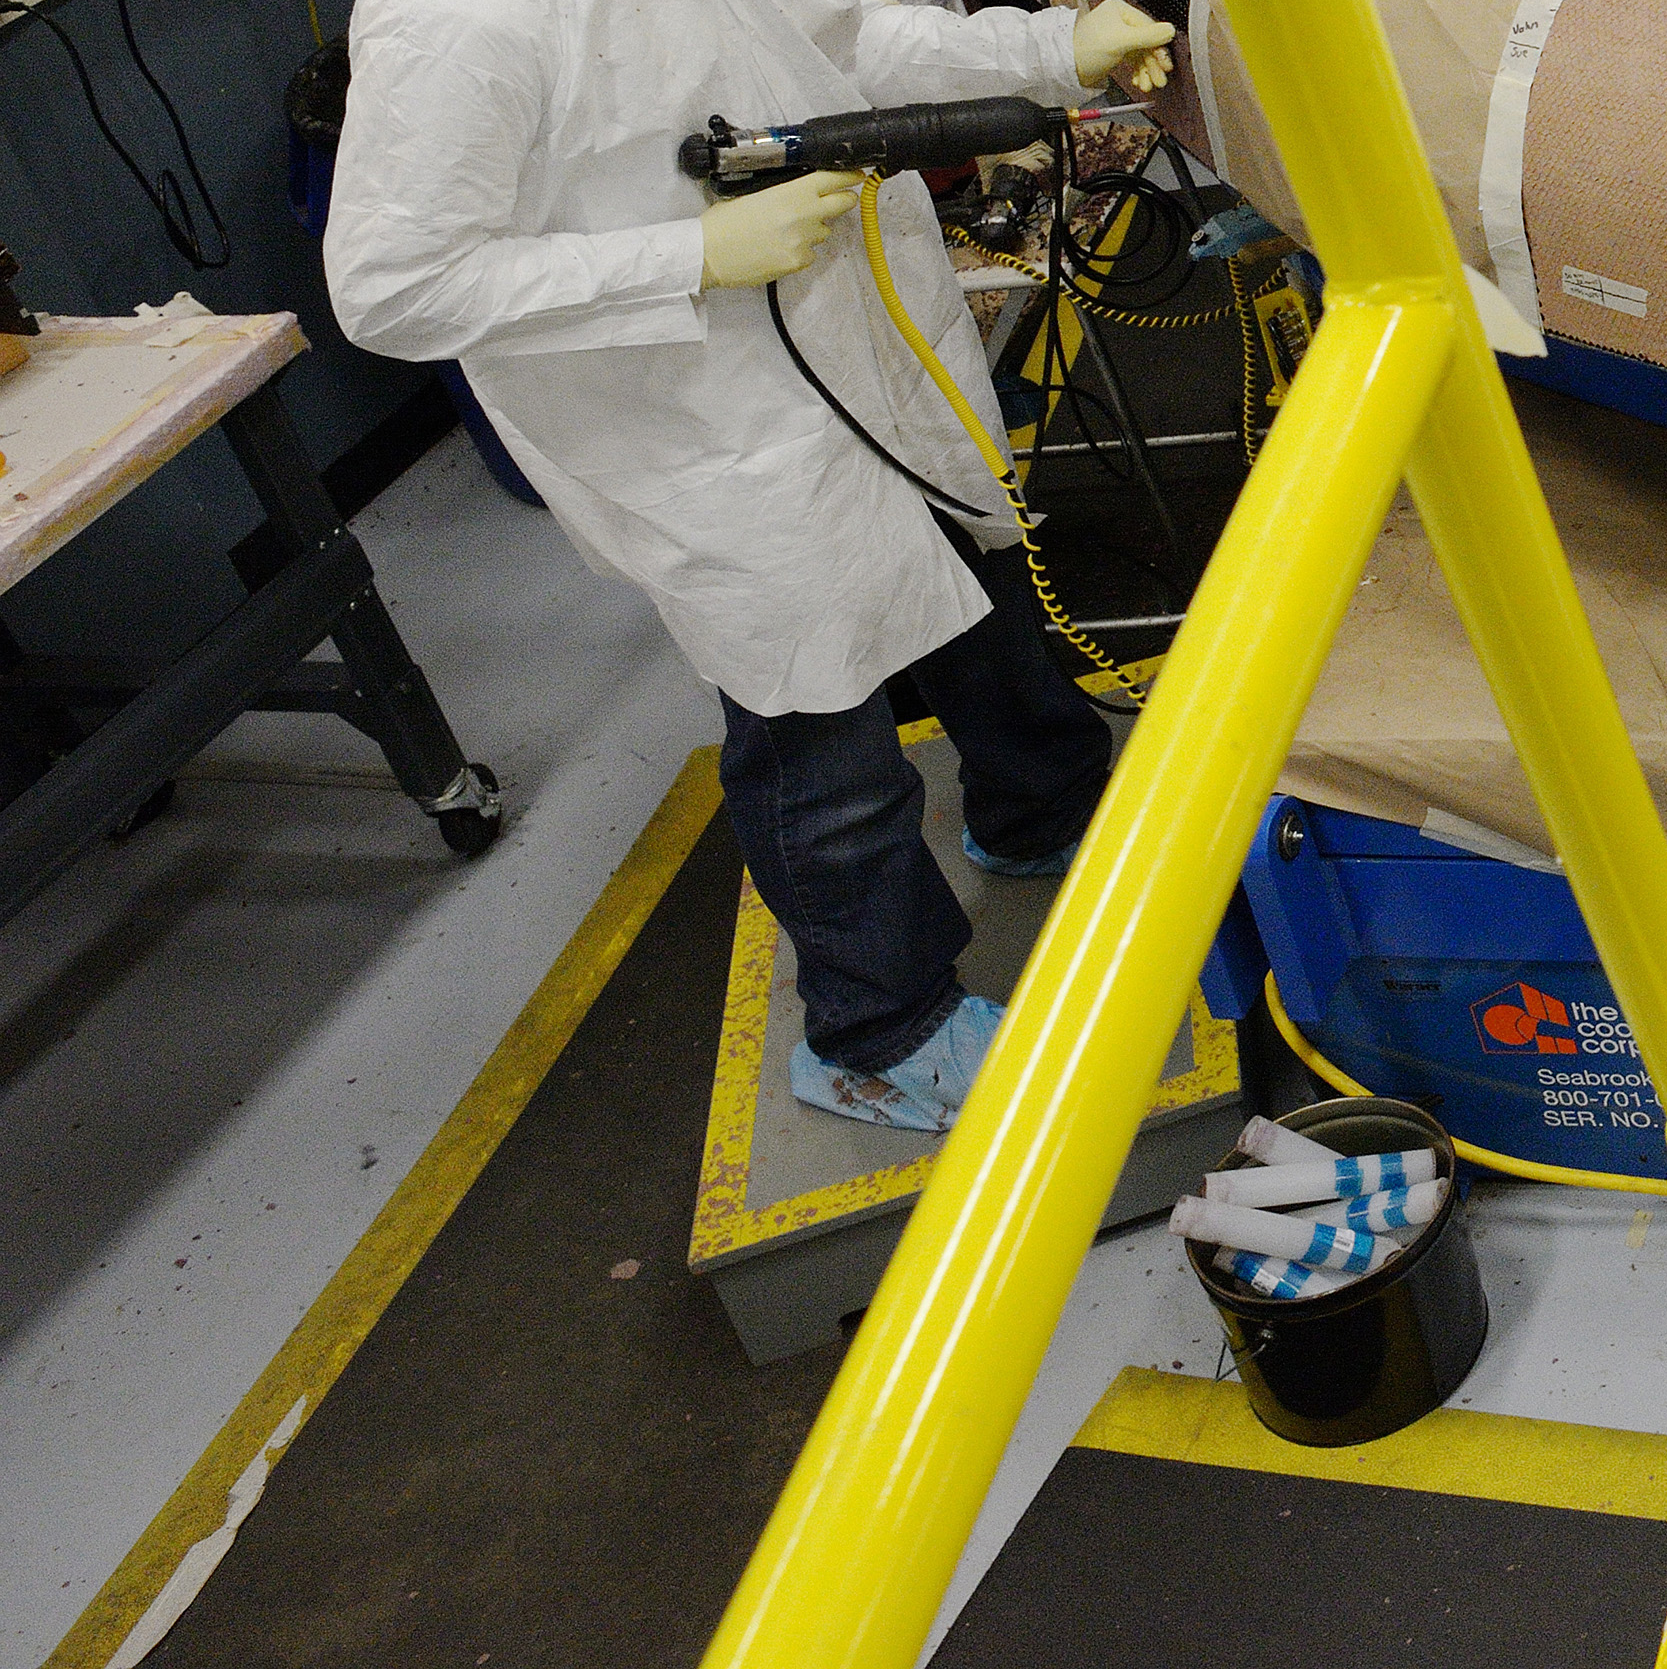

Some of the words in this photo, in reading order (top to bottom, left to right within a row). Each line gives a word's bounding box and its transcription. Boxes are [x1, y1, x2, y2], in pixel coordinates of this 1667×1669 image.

[1571, 1001, 1618, 1022] the
[1576, 1021, 1633, 1039] coo
[1582, 1037, 1641, 1058] corp
[1537, 1067, 1652, 1087] Seabrook
[1542, 1089, 1663, 1108] 800-701-
[1543, 1109, 1603, 1129] SER.
[1611, 1111, 1659, 1129] NO.
